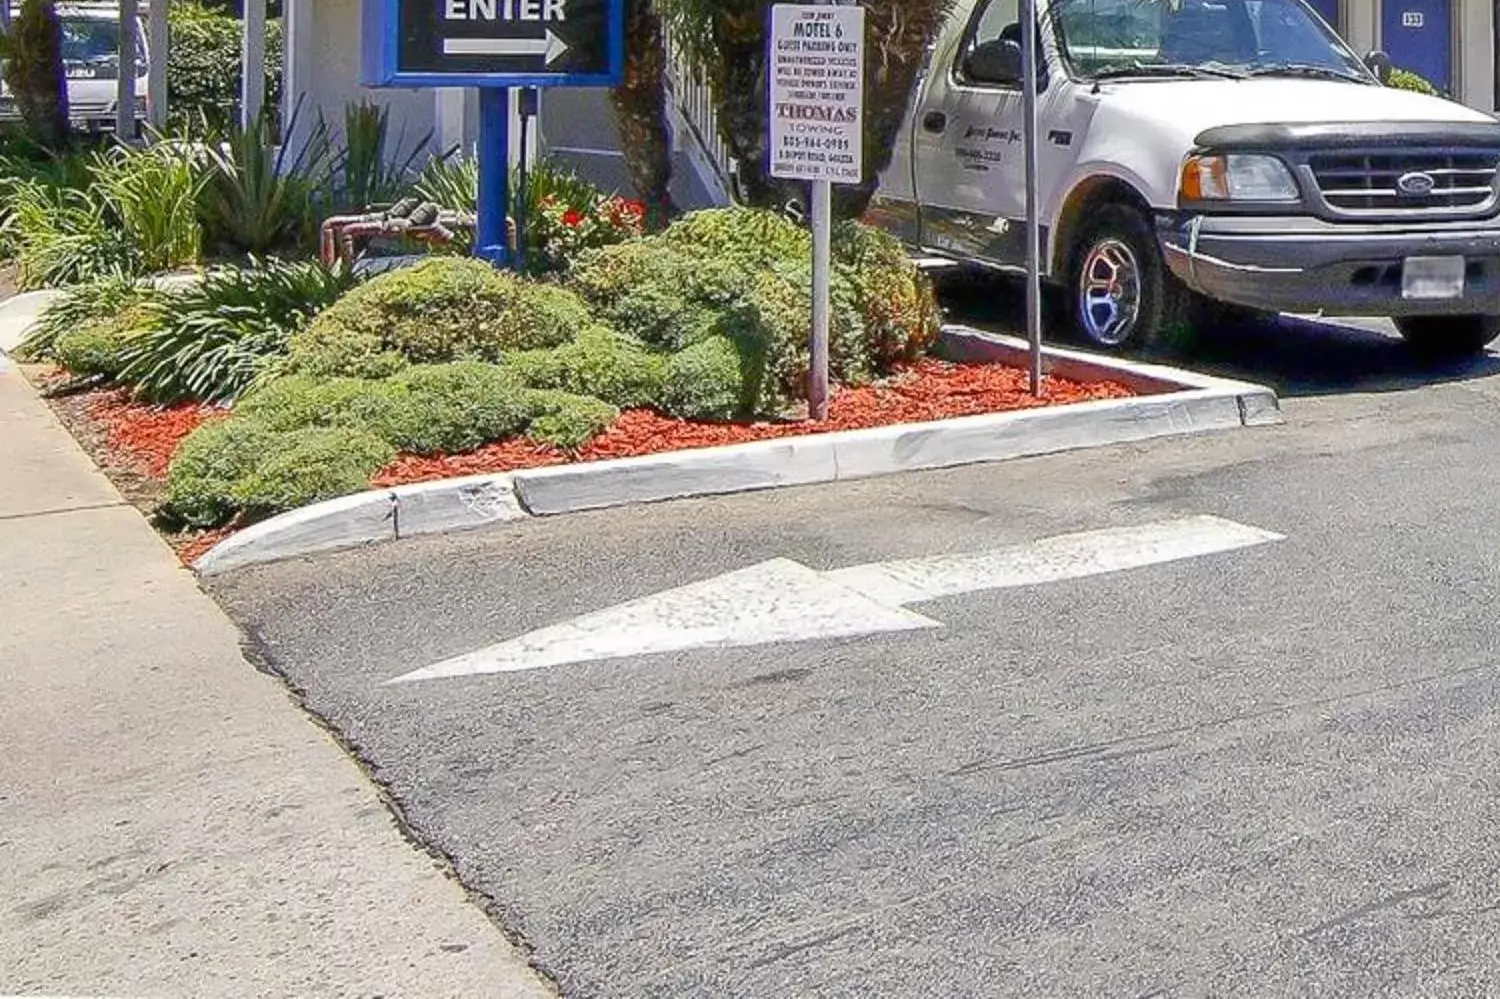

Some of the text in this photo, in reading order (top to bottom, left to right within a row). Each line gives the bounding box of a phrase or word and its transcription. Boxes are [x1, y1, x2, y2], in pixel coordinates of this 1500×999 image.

[794, 23, 843, 38] MOTEL 6
[837, 42, 857, 52] ONLY
[776, 103, 857, 122] THOMAS
[789, 123, 842, 135] TOWING
